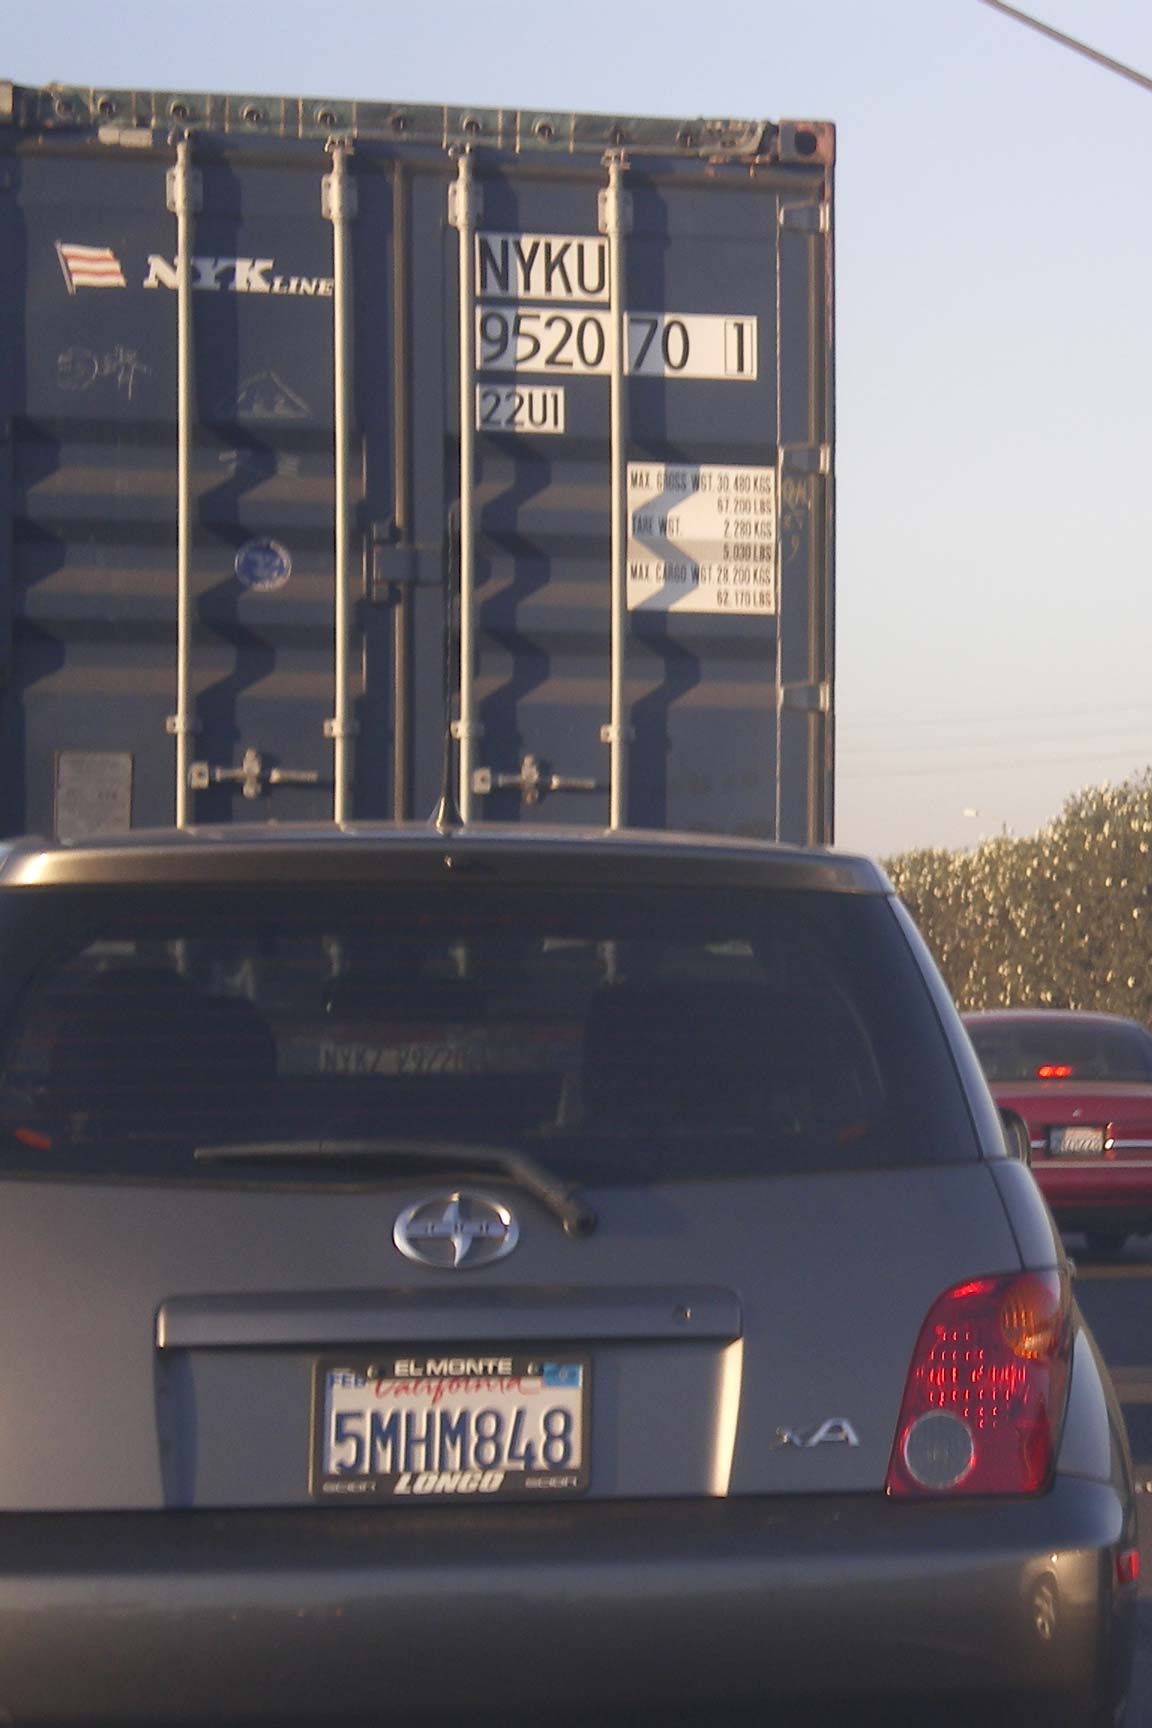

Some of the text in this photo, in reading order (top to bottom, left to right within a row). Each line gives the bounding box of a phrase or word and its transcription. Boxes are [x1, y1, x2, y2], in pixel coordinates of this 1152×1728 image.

[143, 254, 335, 297] NYK LINE
[480, 239, 605, 295] NYKU
[481, 391, 560, 430] 22U1
[656, 472, 687, 491] GROSS
[753, 474, 771, 495] KGS
[754, 497, 772, 514] LBS
[632, 514, 653, 536] TARE
[754, 519, 772, 538] KGS
[754, 544, 772, 562] LBS
[655, 562, 687, 583] CARGO
[753, 565, 771, 585] KGS
[753, 590, 771, 607] LBS
[394, 1357, 513, 1377] EL MONTE
[334, 1408, 572, 1473] 5MHM848
